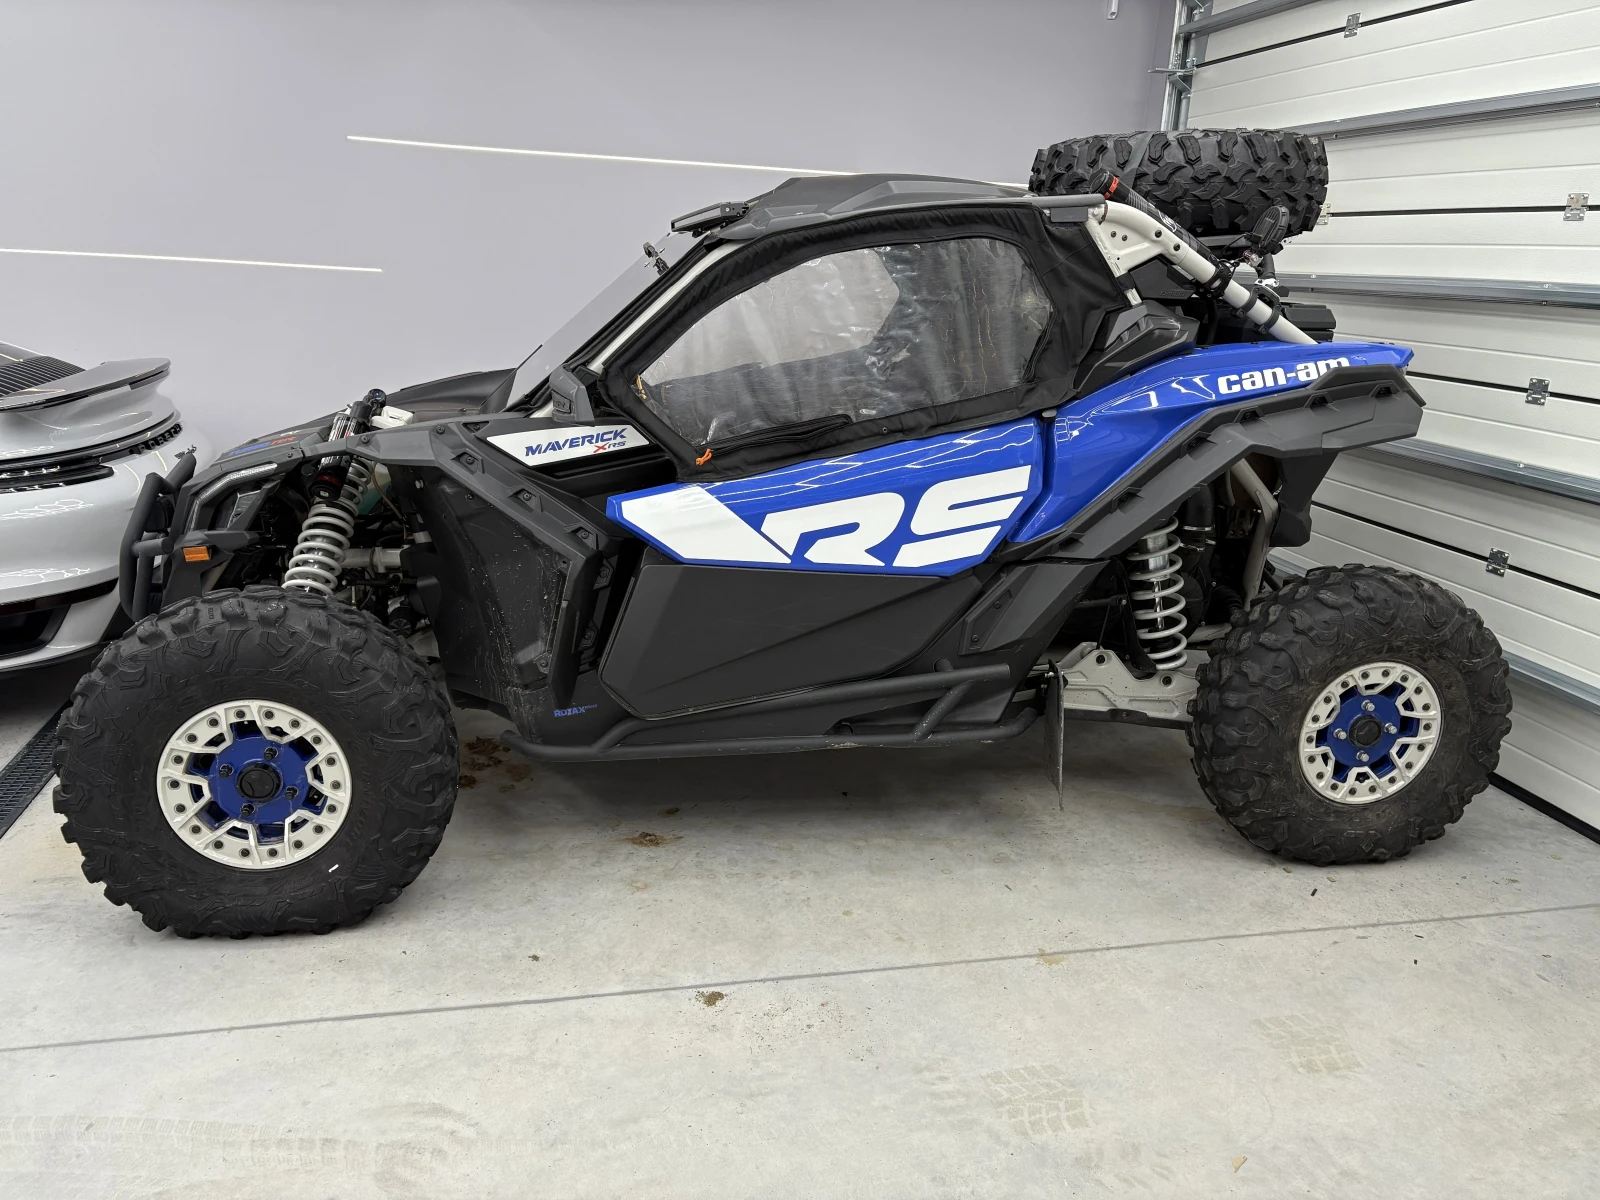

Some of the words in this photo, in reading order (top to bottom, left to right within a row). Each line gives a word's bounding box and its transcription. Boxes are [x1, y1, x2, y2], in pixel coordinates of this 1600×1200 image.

[1217, 357, 1350, 395] can-am
[525, 428, 628, 457] MAVERICK
[760, 464, 1032, 568] RS
[553, 706, 585, 718] ROTAX
